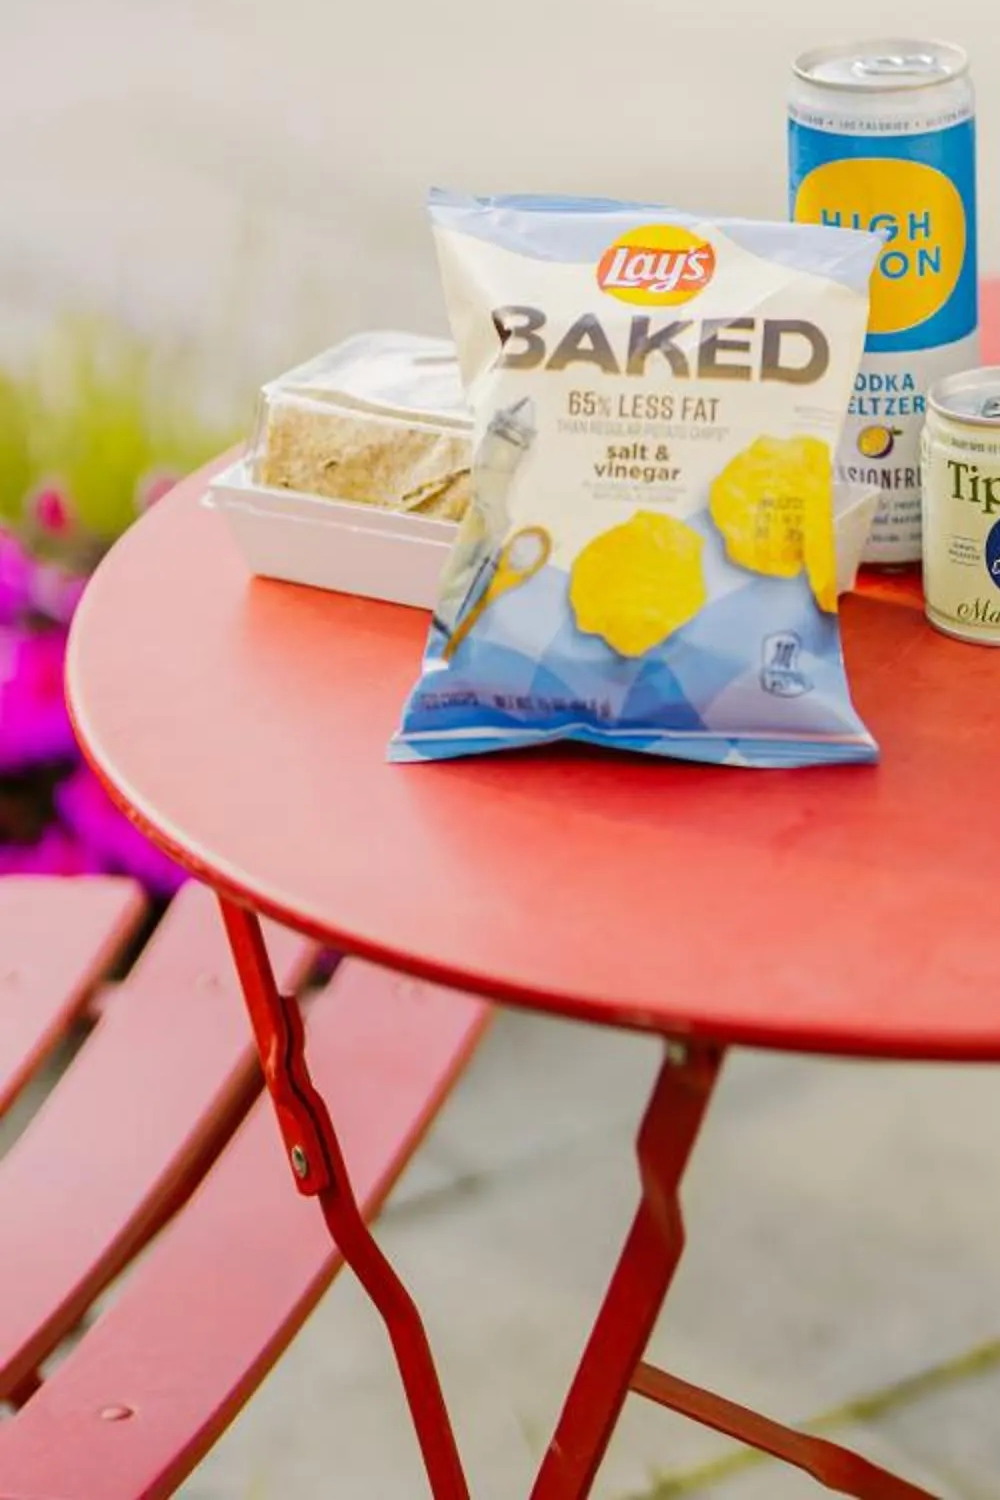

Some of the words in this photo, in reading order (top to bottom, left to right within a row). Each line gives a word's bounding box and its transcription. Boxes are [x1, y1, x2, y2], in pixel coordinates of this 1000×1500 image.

[603, 247, 709, 292] Lay's
[880, 245, 941, 279] ON
[491, 305, 830, 386] BAKED
[854, 373, 915, 392] ODKA
[568, 390, 611, 417] 65%
[618, 394, 674, 420] LESS
[681, 396, 721, 423] FAT
[848, 395, 925, 416] ELTZER
[606, 442, 649, 461] salt
[655, 444, 670, 462] &
[593, 462, 682, 483] vinegar
